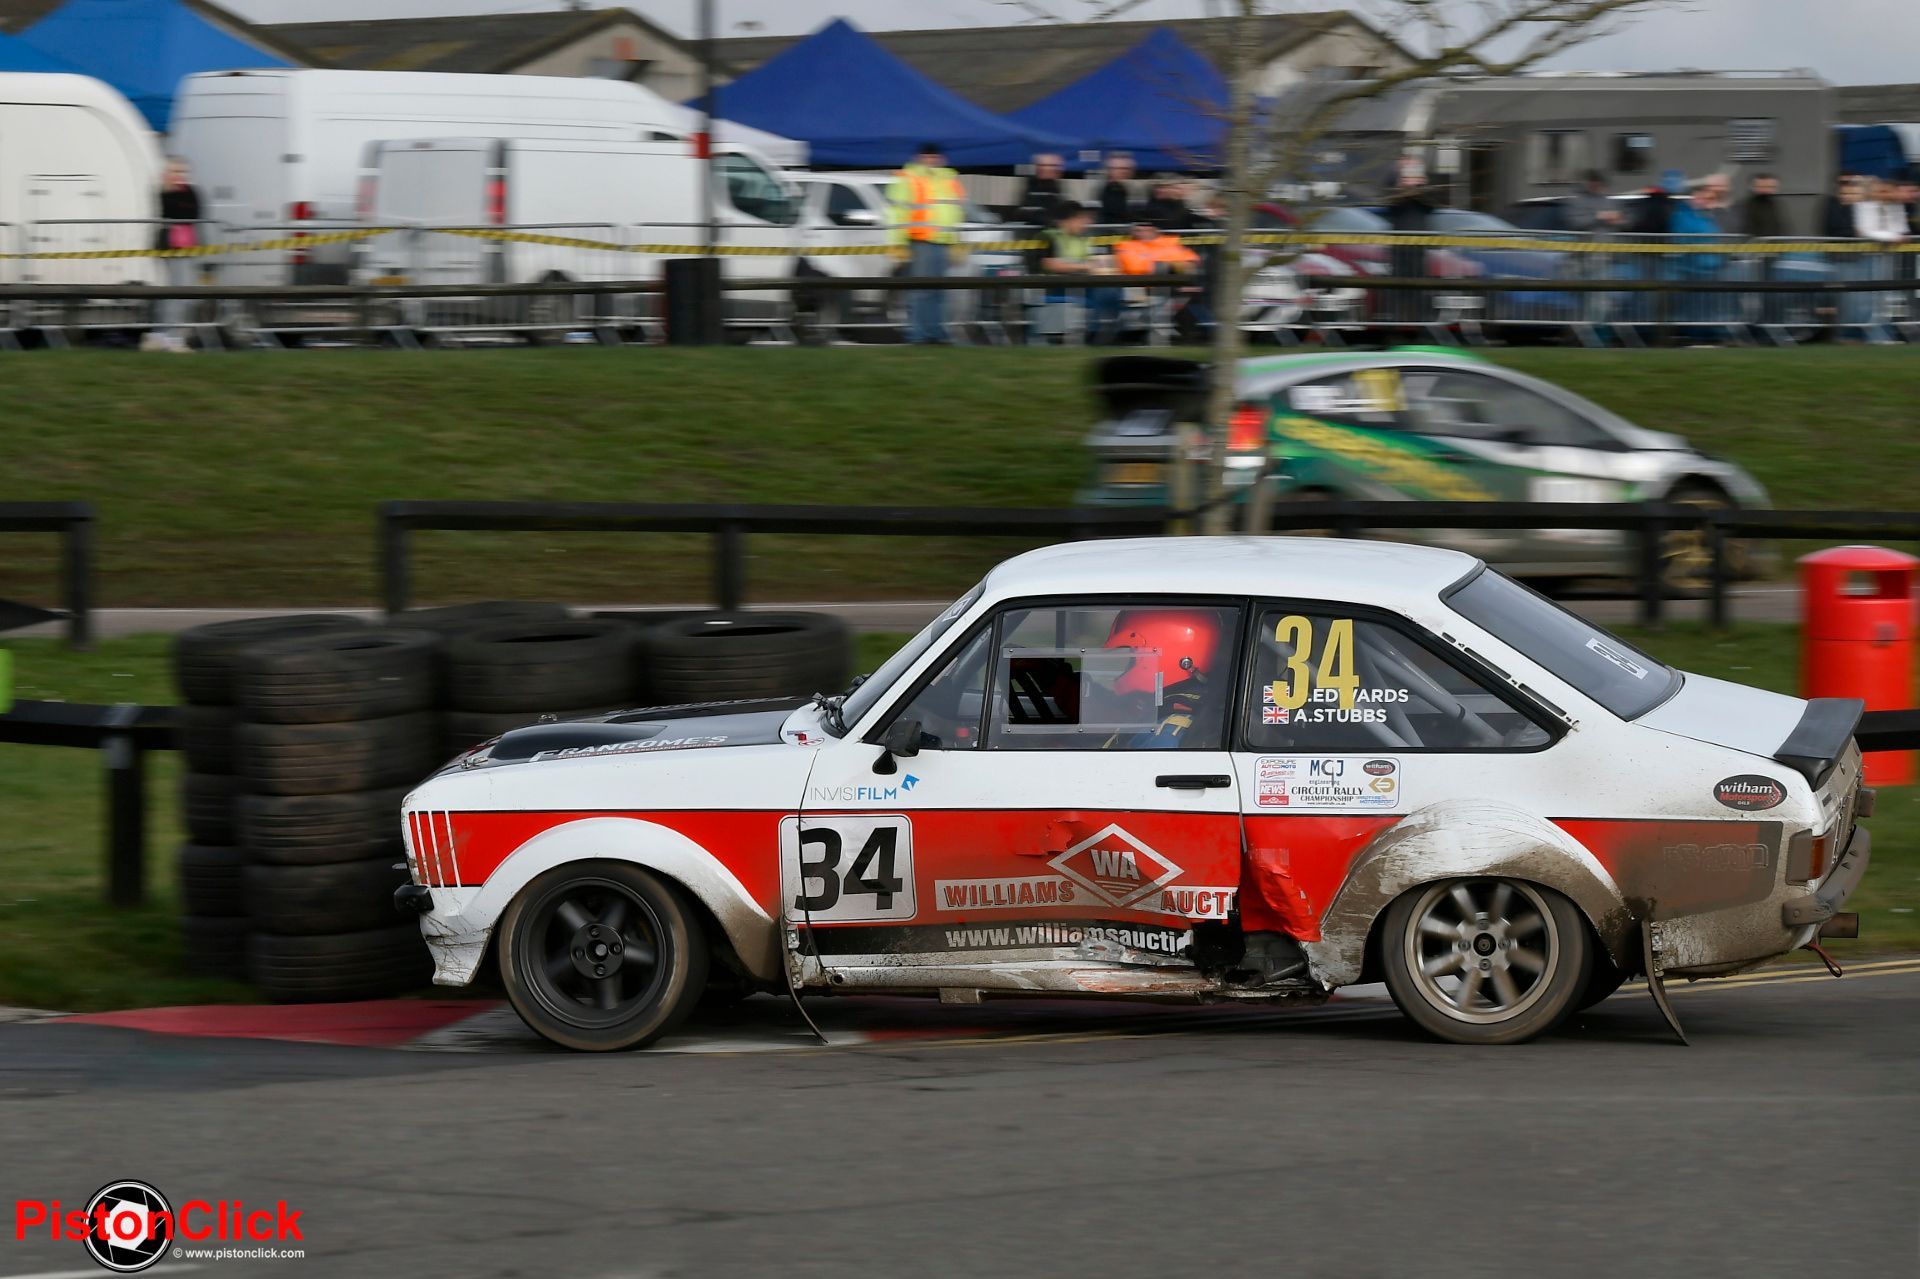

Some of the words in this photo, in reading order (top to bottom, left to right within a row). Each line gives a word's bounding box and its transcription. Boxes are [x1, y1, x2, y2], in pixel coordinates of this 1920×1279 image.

[1272, 614, 1360, 710] 34
[1307, 688, 1409, 703] .EDARDS
[1293, 708, 1388, 723] A.STUBBS
[528, 735, 730, 763] FRANCOME'S
[809, 786, 898, 801] INVISIFILM
[1260, 784, 1285, 795] NEWS
[1291, 786, 1330, 796] CIRCUIT
[1333, 786, 1364, 797] RALLY
[1720, 782, 1773, 794] witham
[1300, 795, 1354, 803] CHAMPIONSHIP
[794, 826, 903, 912] 34
[1090, 849, 1141, 881] WA
[944, 880, 1075, 908] WILLIAMS
